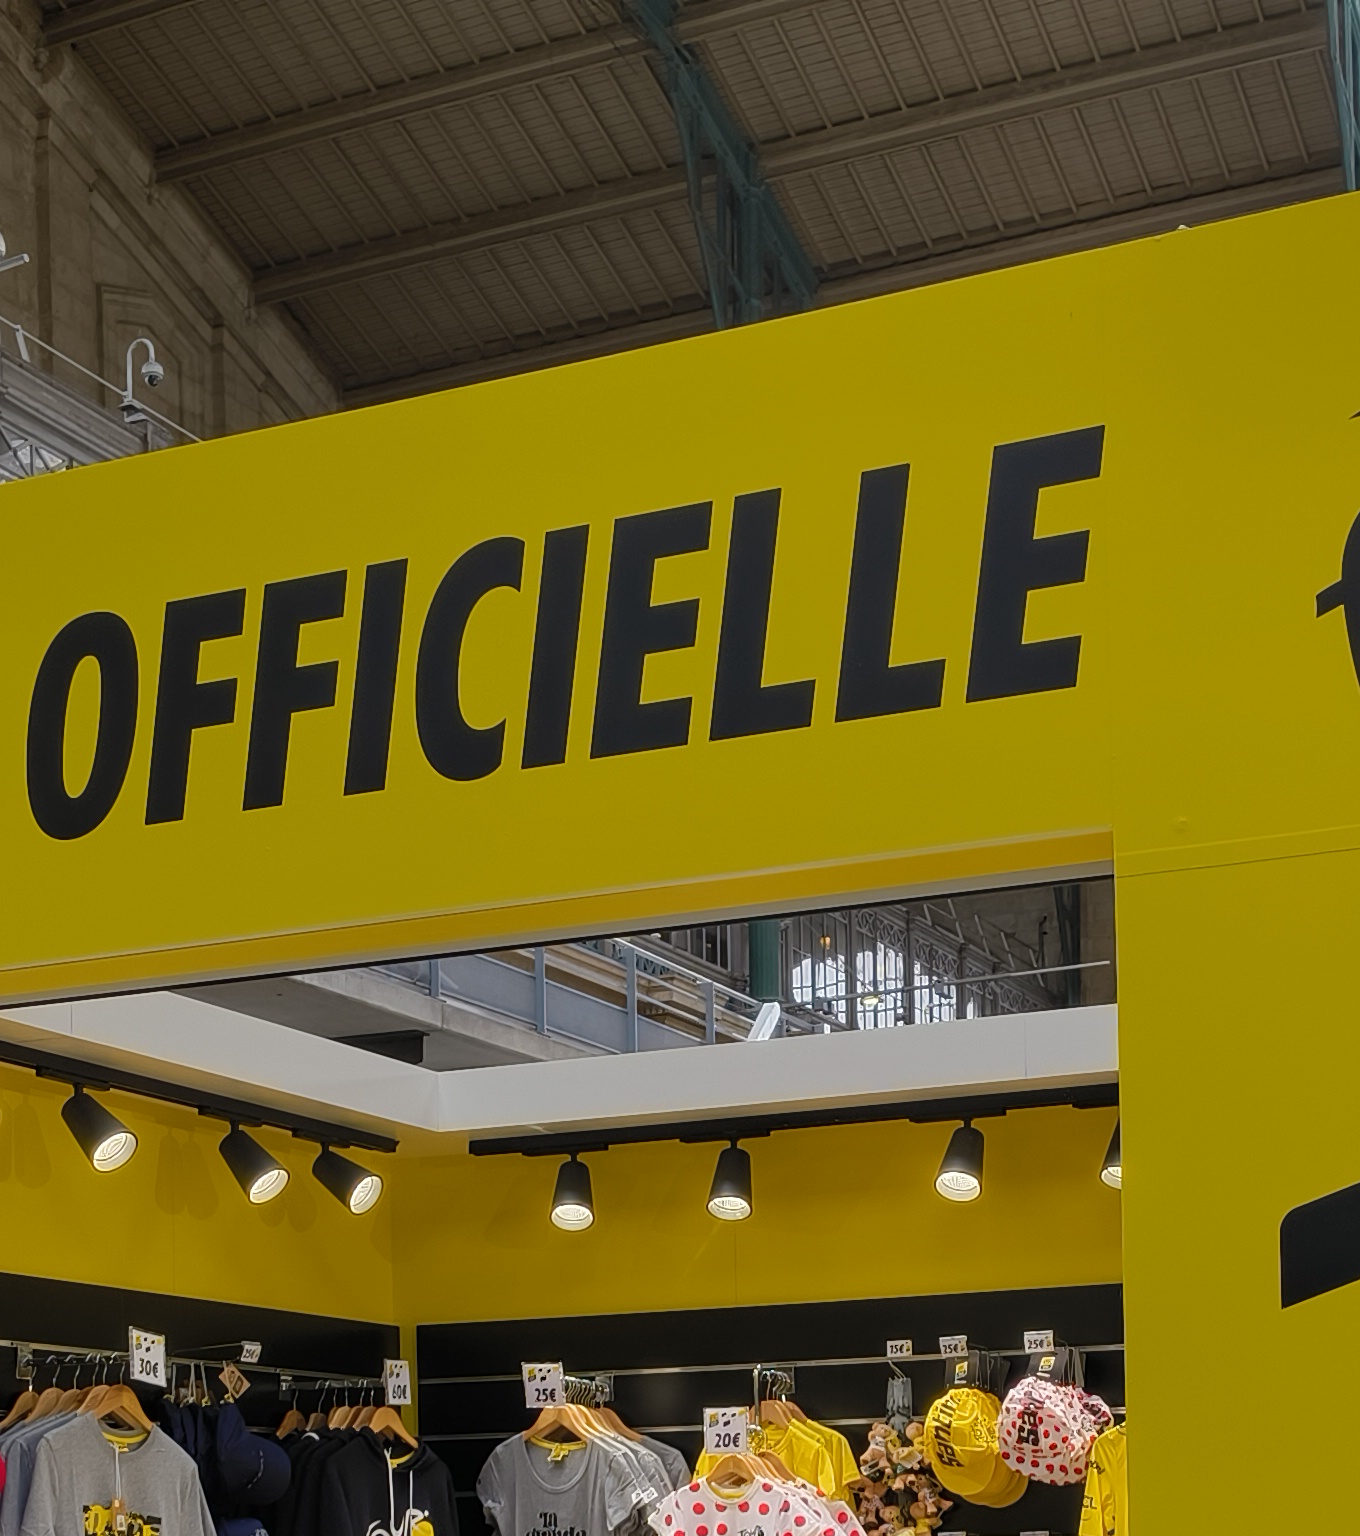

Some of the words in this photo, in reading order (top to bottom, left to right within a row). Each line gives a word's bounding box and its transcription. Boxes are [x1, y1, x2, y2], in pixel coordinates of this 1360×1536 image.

[26, 424, 1105, 842] OFFICIELLE
[138, 1357, 159, 1378] 30€
[390, 1381, 409, 1402] 60€
[534, 1387, 557, 1403] 25€
[714, 1432, 741, 1448] 20€
